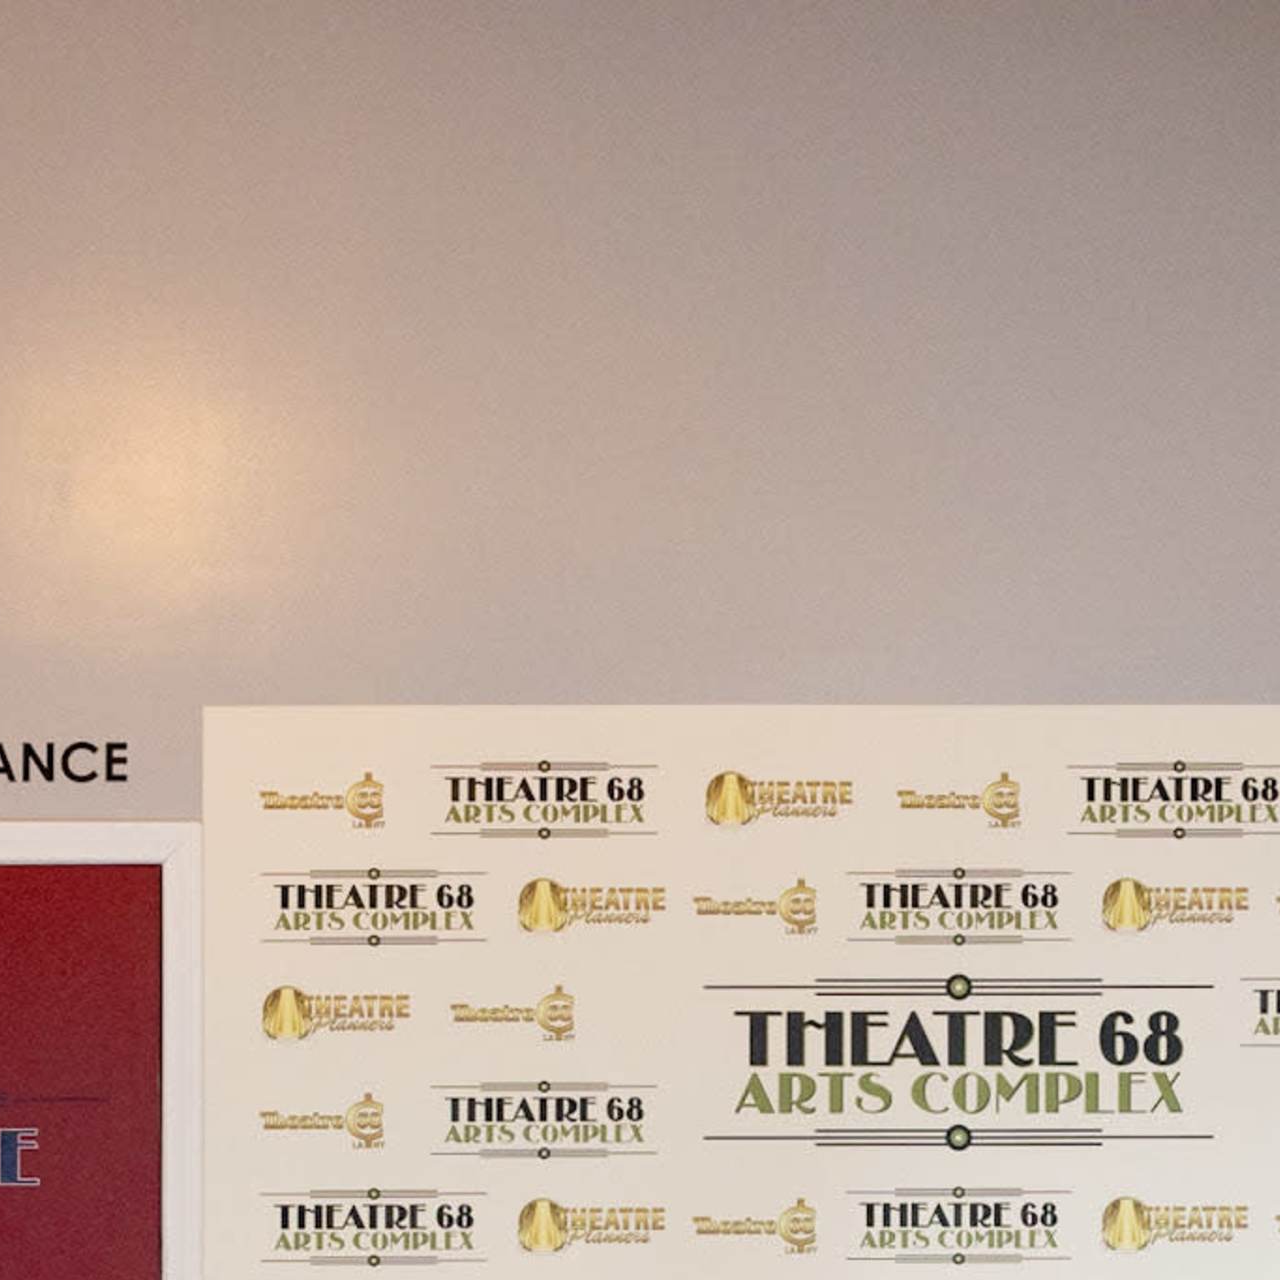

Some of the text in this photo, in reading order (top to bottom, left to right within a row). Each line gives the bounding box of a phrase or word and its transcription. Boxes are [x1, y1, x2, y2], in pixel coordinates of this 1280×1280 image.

[444, 776, 645, 803] THEATRE 68
[747, 780, 853, 805] THEATRE
[1079, 776, 1280, 803] THEATRE 68
[444, 804, 645, 823] ARTS COMPLEX
[1079, 804, 1280, 823] ARTS COMPLEX
[274, 883, 475, 910] THEATRE 68
[560, 887, 666, 912] THEATRE
[859, 883, 1060, 910] THEATRE 68
[1143, 886, 1249, 911] THEATRE
[274, 911, 475, 930] ARTS COMPLEX
[859, 911, 1060, 930] ARTS COMPLEX
[304, 994, 410, 1019] THEATRE
[734, 1010, 1184, 1067] THEATRE 68
[734, 1071, 1184, 1115] ARTS COMPLEX
[444, 1096, 645, 1123] THEATRE 68
[444, 1124, 645, 1143] ARTS COMPLEX
[274, 1203, 475, 1230] THEATRE 68
[559, 1207, 665, 1232] THEATRE
[858, 1202, 1059, 1229] THEATRE 68
[1143, 1205, 1249, 1230] THEATRE
[274, 1231, 475, 1250] ARTS COMPLEX
[858, 1230, 1059, 1249] ARTS COMPLEX
